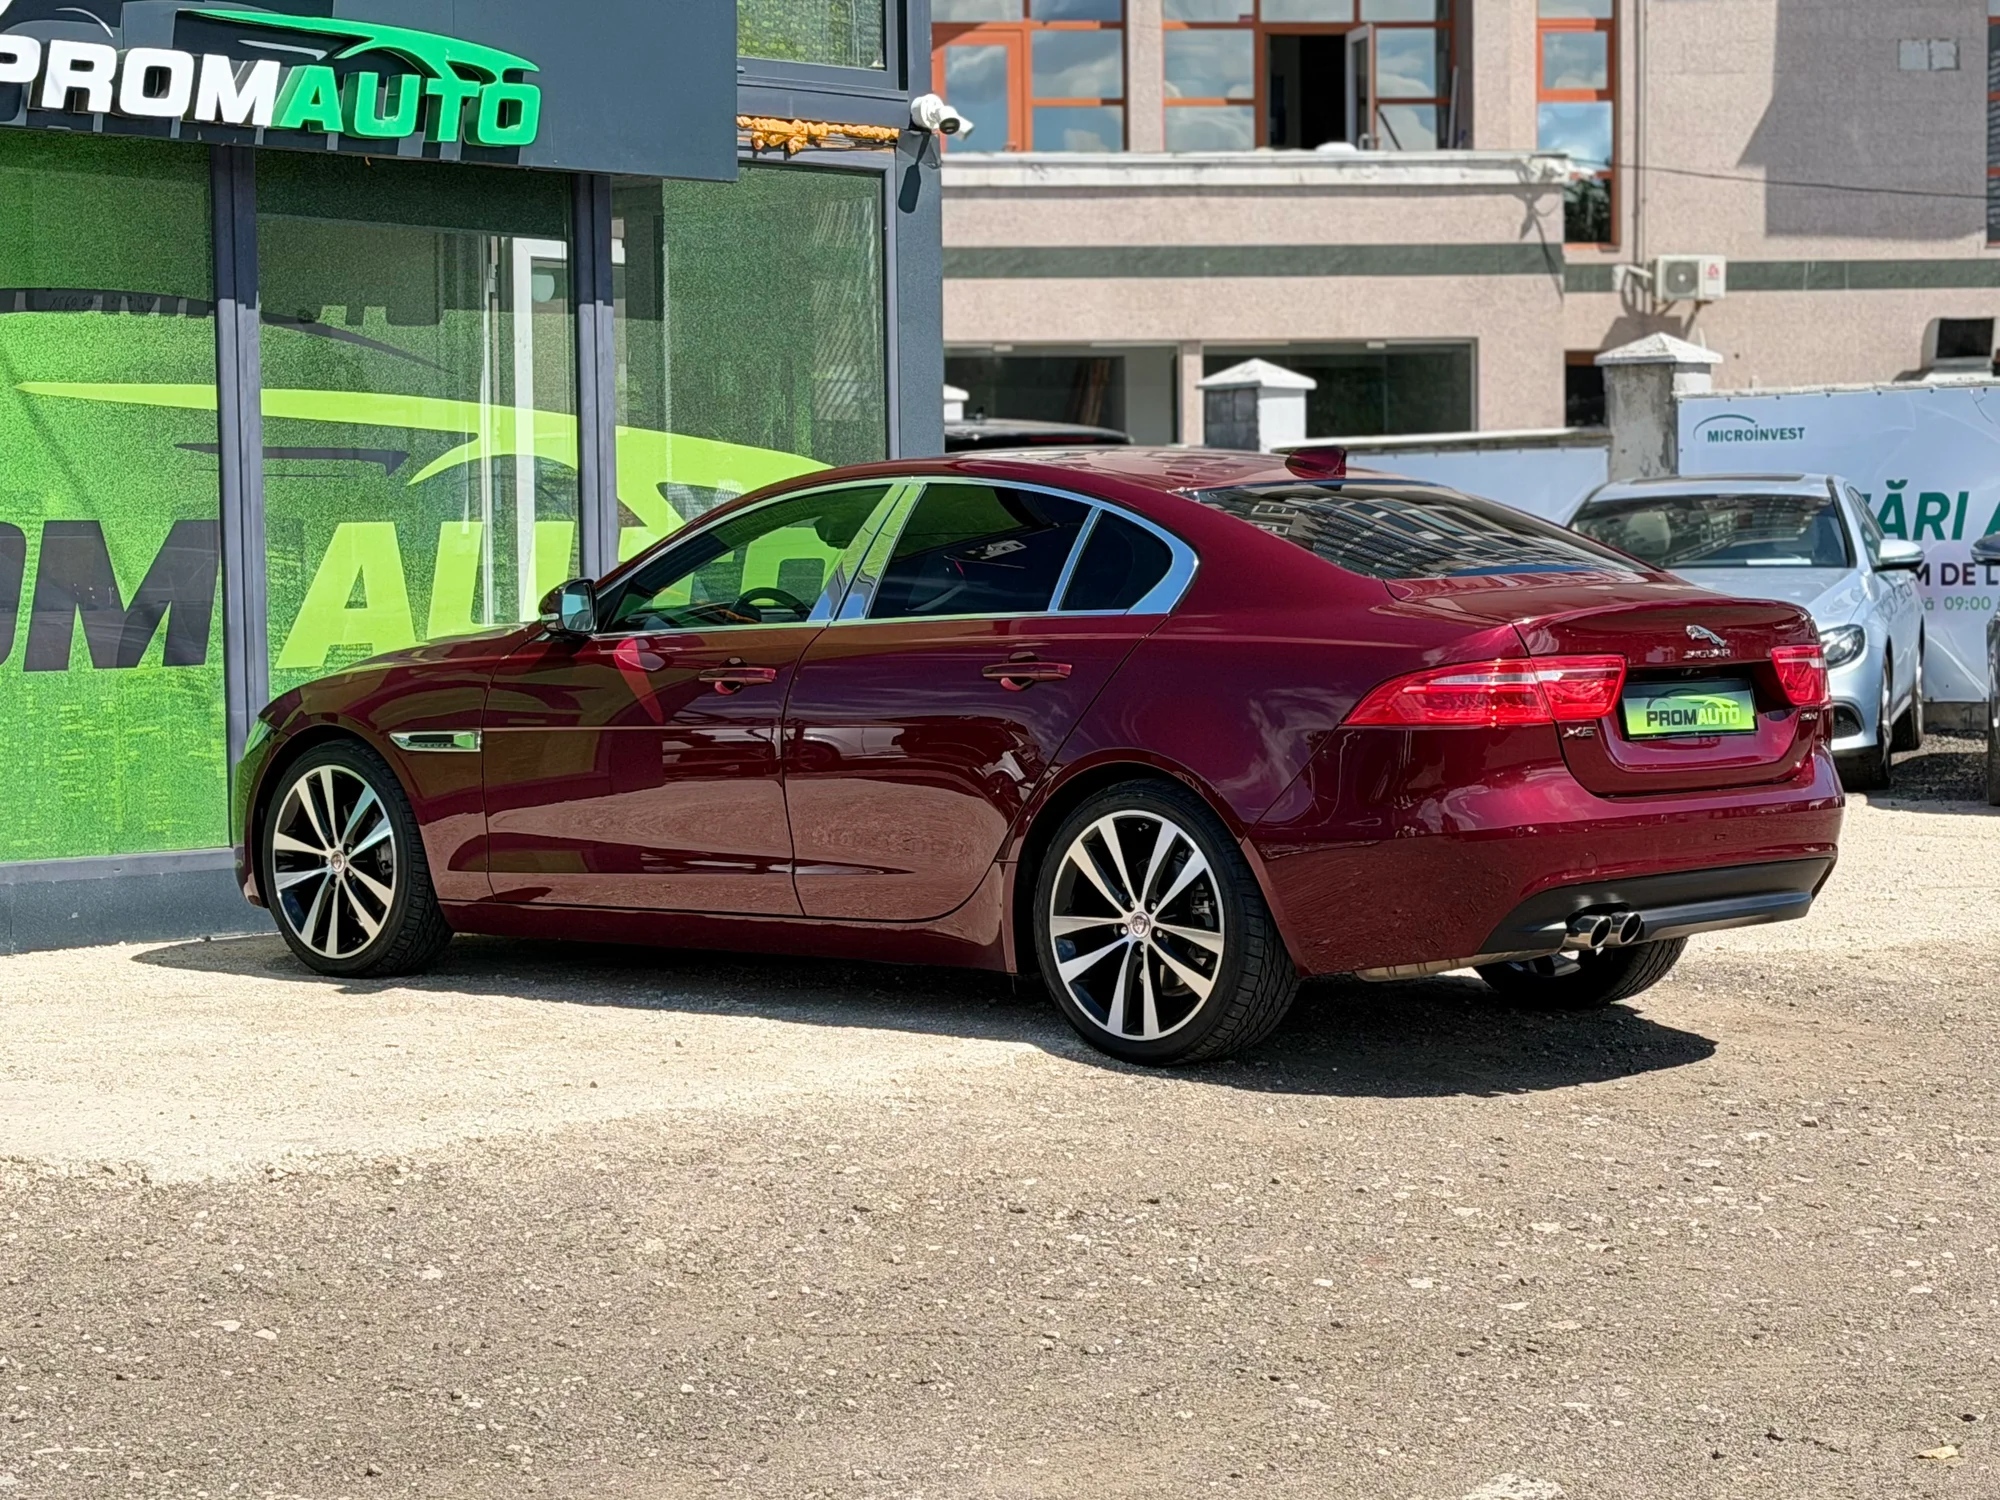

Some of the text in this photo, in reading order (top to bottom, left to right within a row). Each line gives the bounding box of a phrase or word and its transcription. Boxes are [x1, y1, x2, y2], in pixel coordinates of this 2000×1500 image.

[1862, 479, 1969, 541] ĂRI
[1940, 562, 1976, 586] DE
[0, 519, 220, 672] M
[1944, 596, 1991, 611] 09:00
[1646, 707, 1740, 727] PROMAUTO
[1563, 726, 1597, 738] XE
